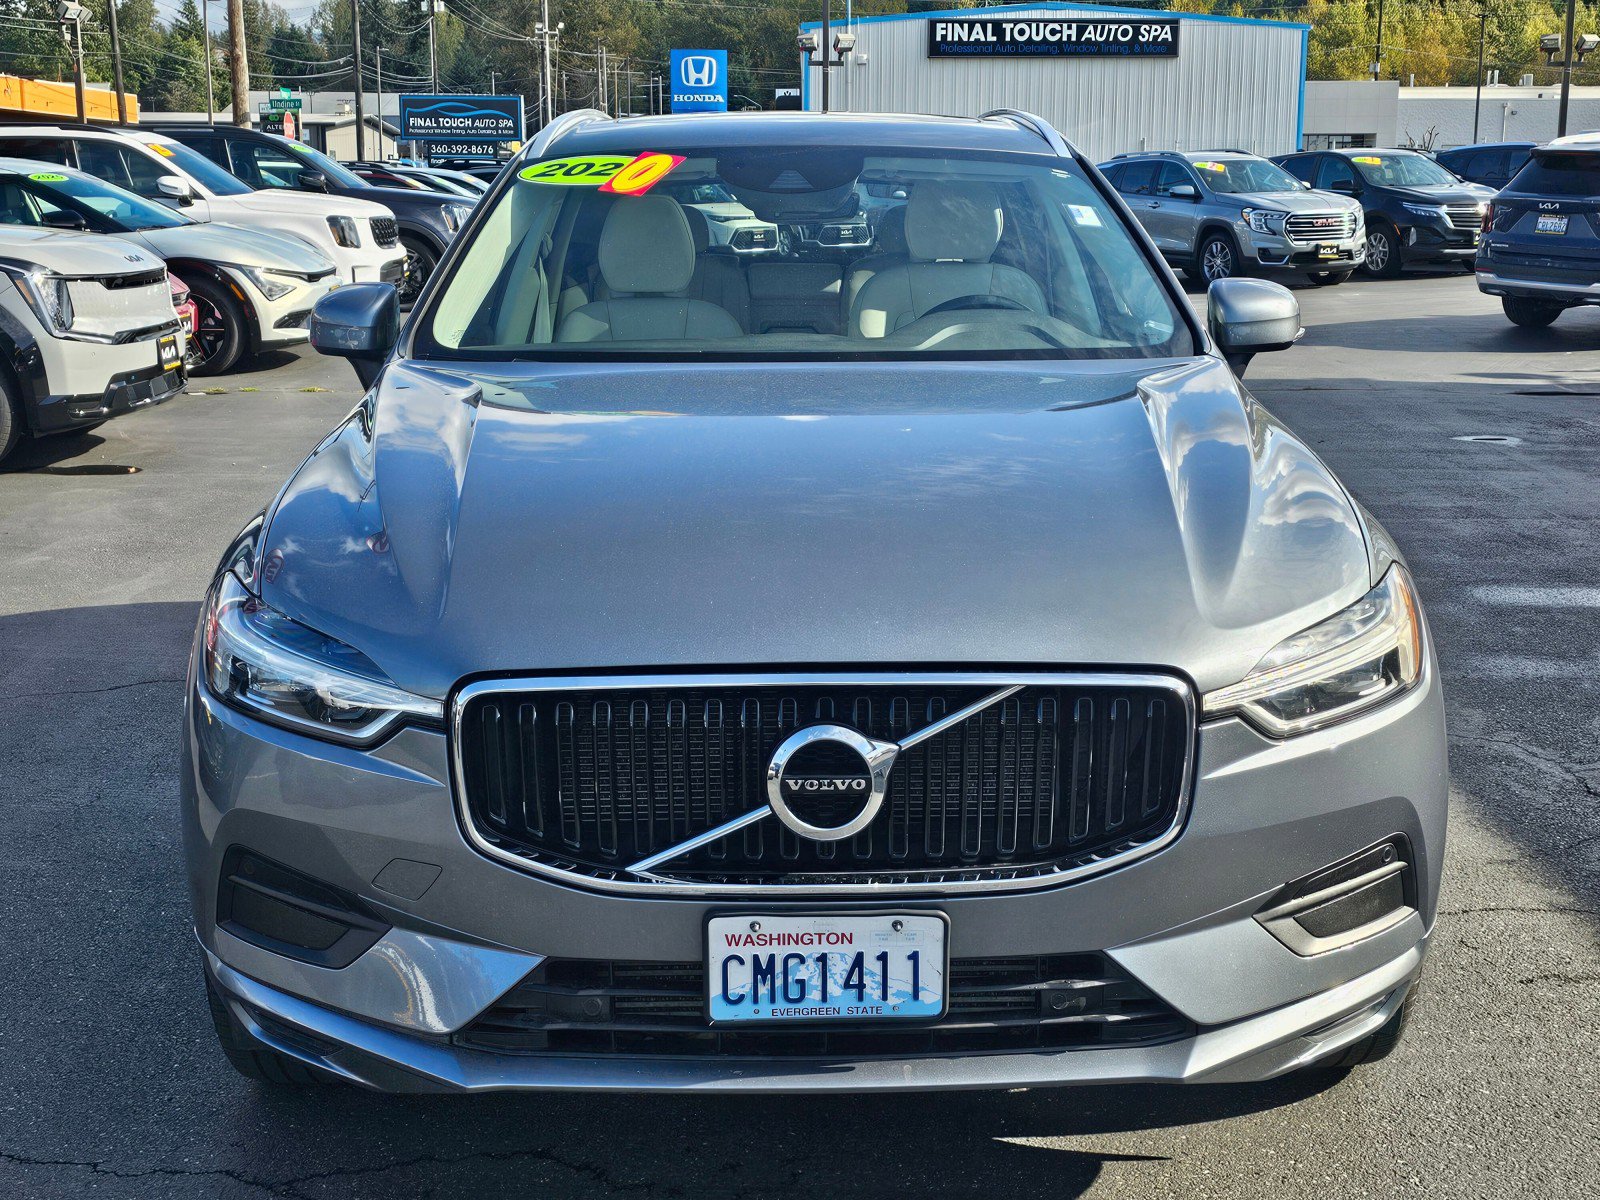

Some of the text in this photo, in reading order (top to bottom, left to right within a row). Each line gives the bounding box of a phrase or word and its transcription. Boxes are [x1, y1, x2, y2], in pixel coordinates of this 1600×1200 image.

[935, 22, 1173, 42] FINAL TOUCH AUTO SPA
[940, 43, 1168, 55] Professional Auto Detailing, Window Tinting, & More
[272, 100, 295, 108] Undine
[673, 94, 725, 103] HONDA
[409, 117, 514, 128] FINAL TOUCH AUTO SPA
[430, 144, 494, 154] 360-392-8676
[785, 779, 867, 791] VOLVO
[724, 931, 854, 947] WASHINGTON
[721, 950, 921, 1005] CMG1411
[771, 1005, 883, 1017] EVERGREEN STATE
